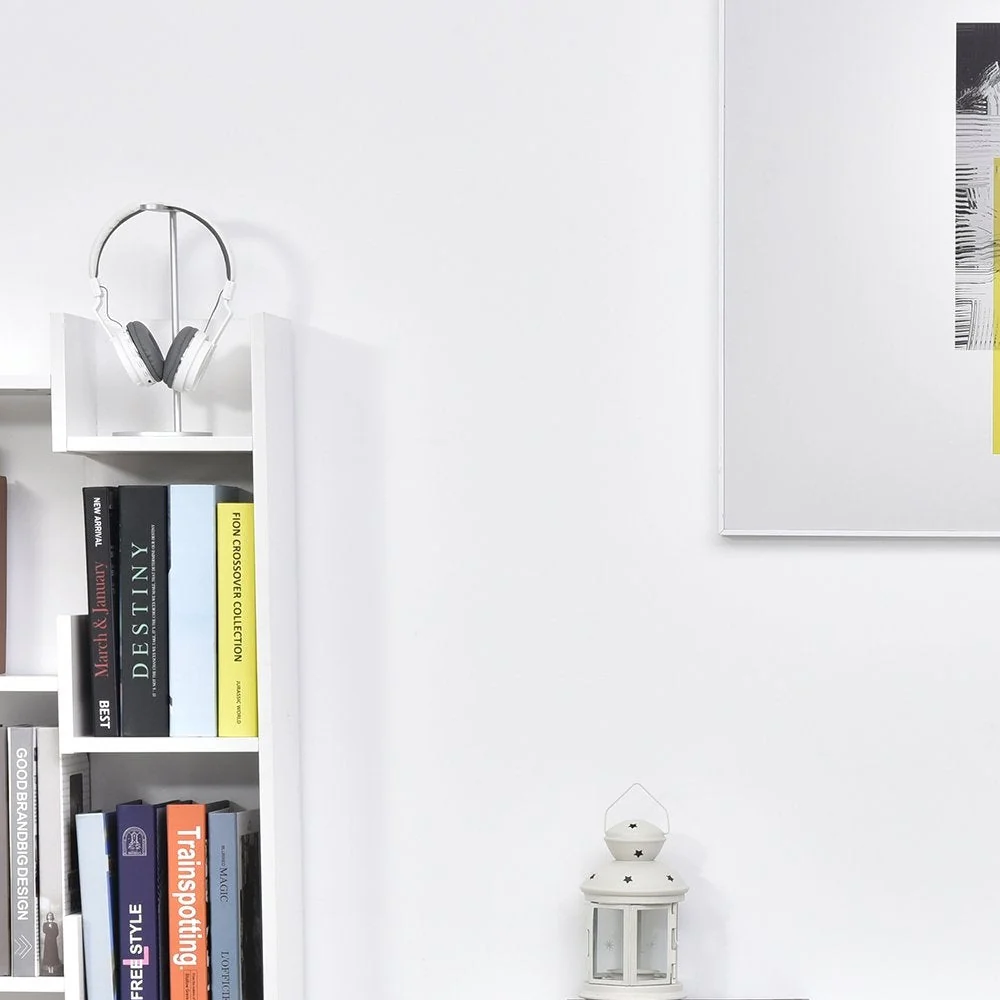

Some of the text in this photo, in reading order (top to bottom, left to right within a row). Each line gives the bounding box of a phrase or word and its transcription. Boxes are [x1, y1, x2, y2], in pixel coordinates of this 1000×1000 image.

[94, 516, 102, 547] ARRIVAL
[92, 562, 108, 678] March & January
[132, 542, 149, 679] DESTINY
[232, 512, 242, 662] FION CROSSOVER COLLECTION
[100, 701, 110, 728] BEST
[16, 748, 28, 791] GOOD
[220, 868, 228, 903] MAGIC
[129, 904, 144, 1000] FREE STYLE
